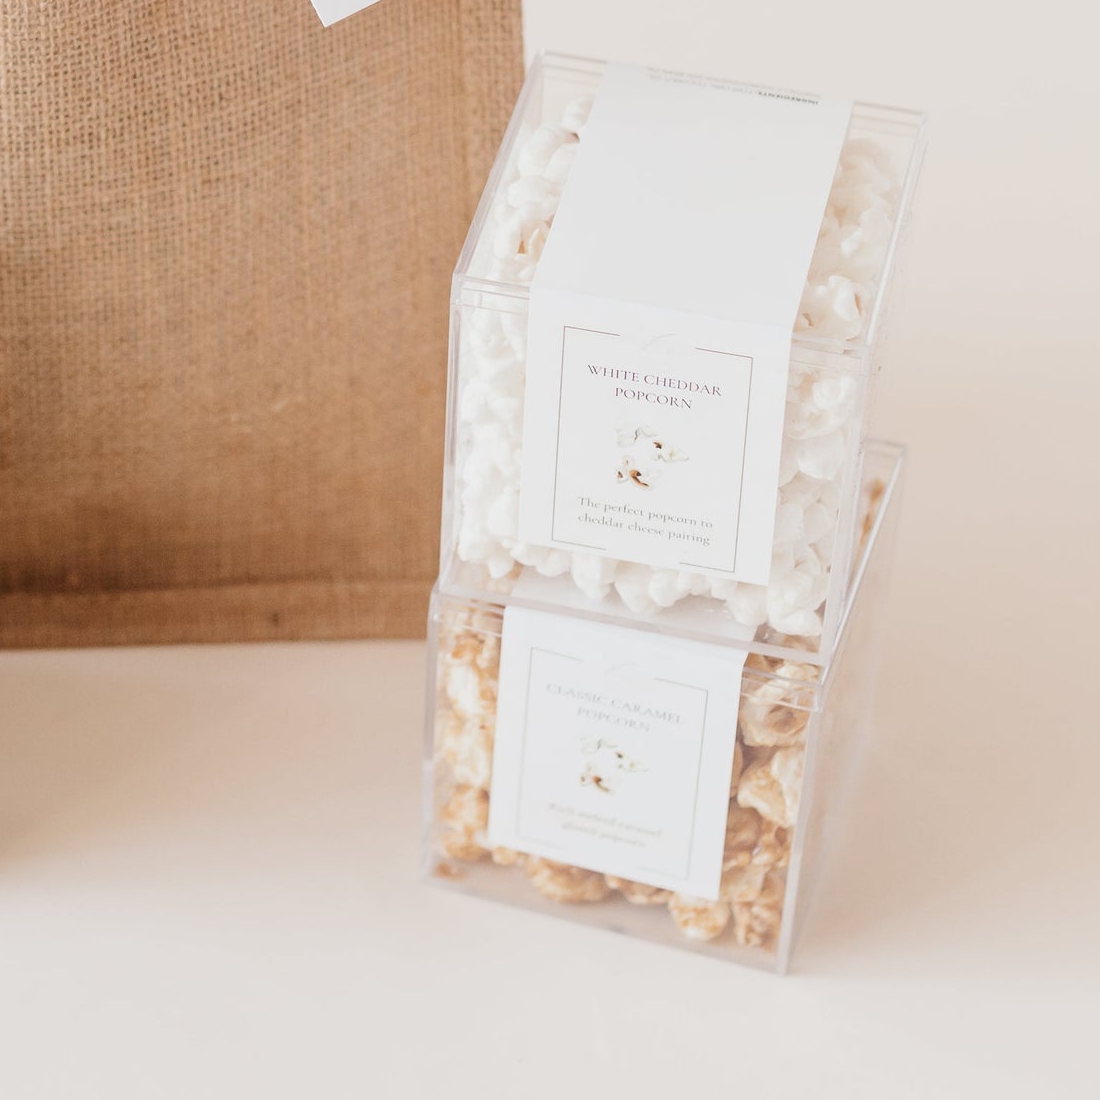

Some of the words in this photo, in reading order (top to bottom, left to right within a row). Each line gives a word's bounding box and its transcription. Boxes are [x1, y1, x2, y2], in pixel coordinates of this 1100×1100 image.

[587, 363, 640, 383] WHITE
[643, 375, 722, 397] CHEDDAR
[614, 387, 693, 409] POPCORN
[577, 496, 601, 509] The
[604, 502, 644, 517] perfect
[648, 510, 697, 527] popcorn
[701, 519, 713, 529] to
[577, 513, 624, 530] cheddar
[627, 521, 665, 536] cheese
[668, 529, 711, 546] pairing
[546, 683, 608, 707] CLASSIC
[611, 698, 685, 725] CARAMEL
[576, 707, 651, 732] POPCORN
